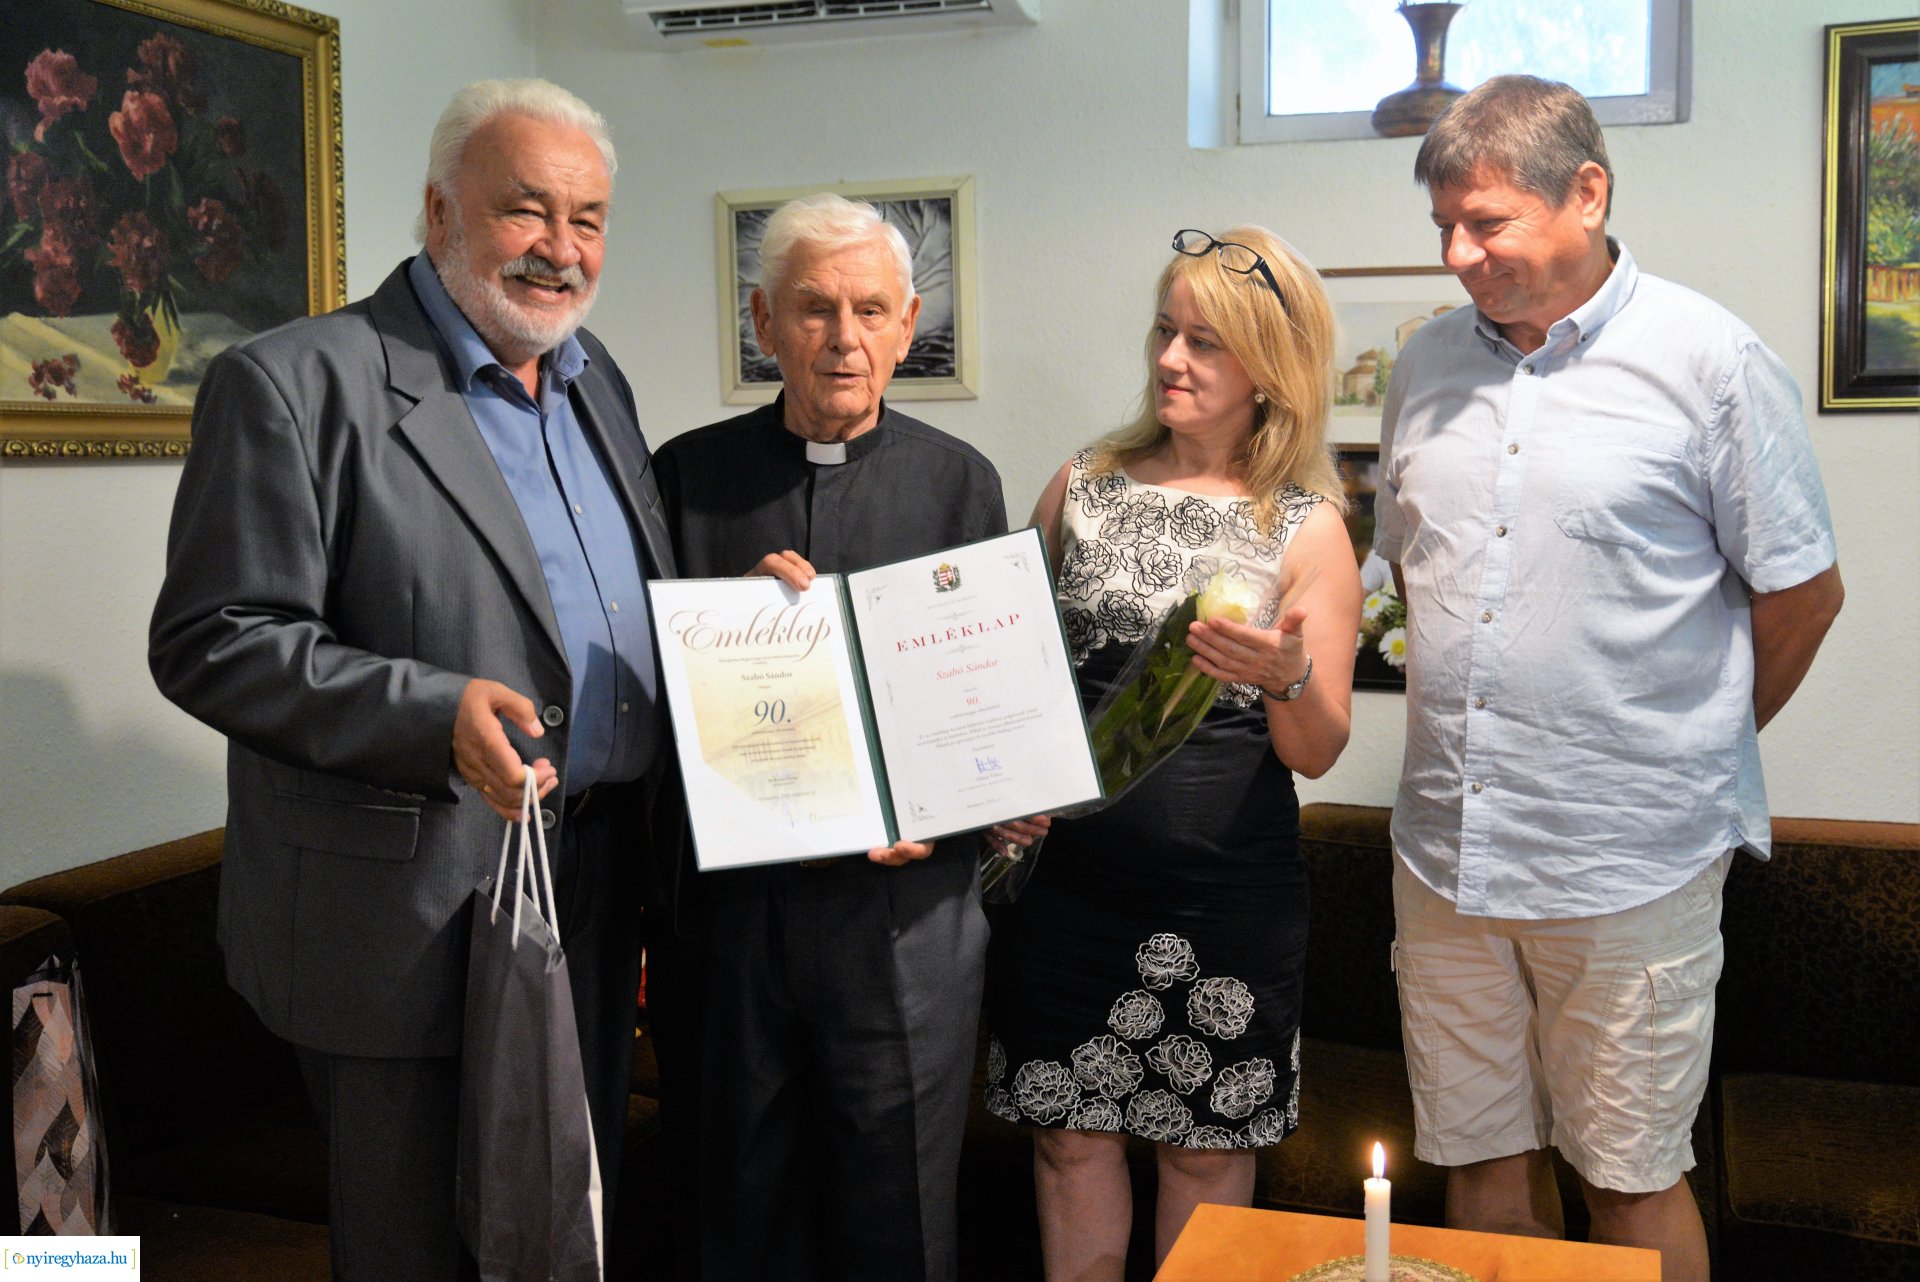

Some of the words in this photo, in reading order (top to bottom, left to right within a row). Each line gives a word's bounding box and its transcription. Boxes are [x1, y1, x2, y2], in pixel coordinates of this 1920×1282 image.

[669, 602, 831, 661] Emléklap
[896, 613, 1021, 653] EMLÉKLAP
[741, 672, 765, 682] Szabó
[766, 670, 793, 681] Sándor
[936, 664, 964, 681] Szabó
[966, 658, 1000, 674] Sándor
[753, 699, 792, 726] 90.
